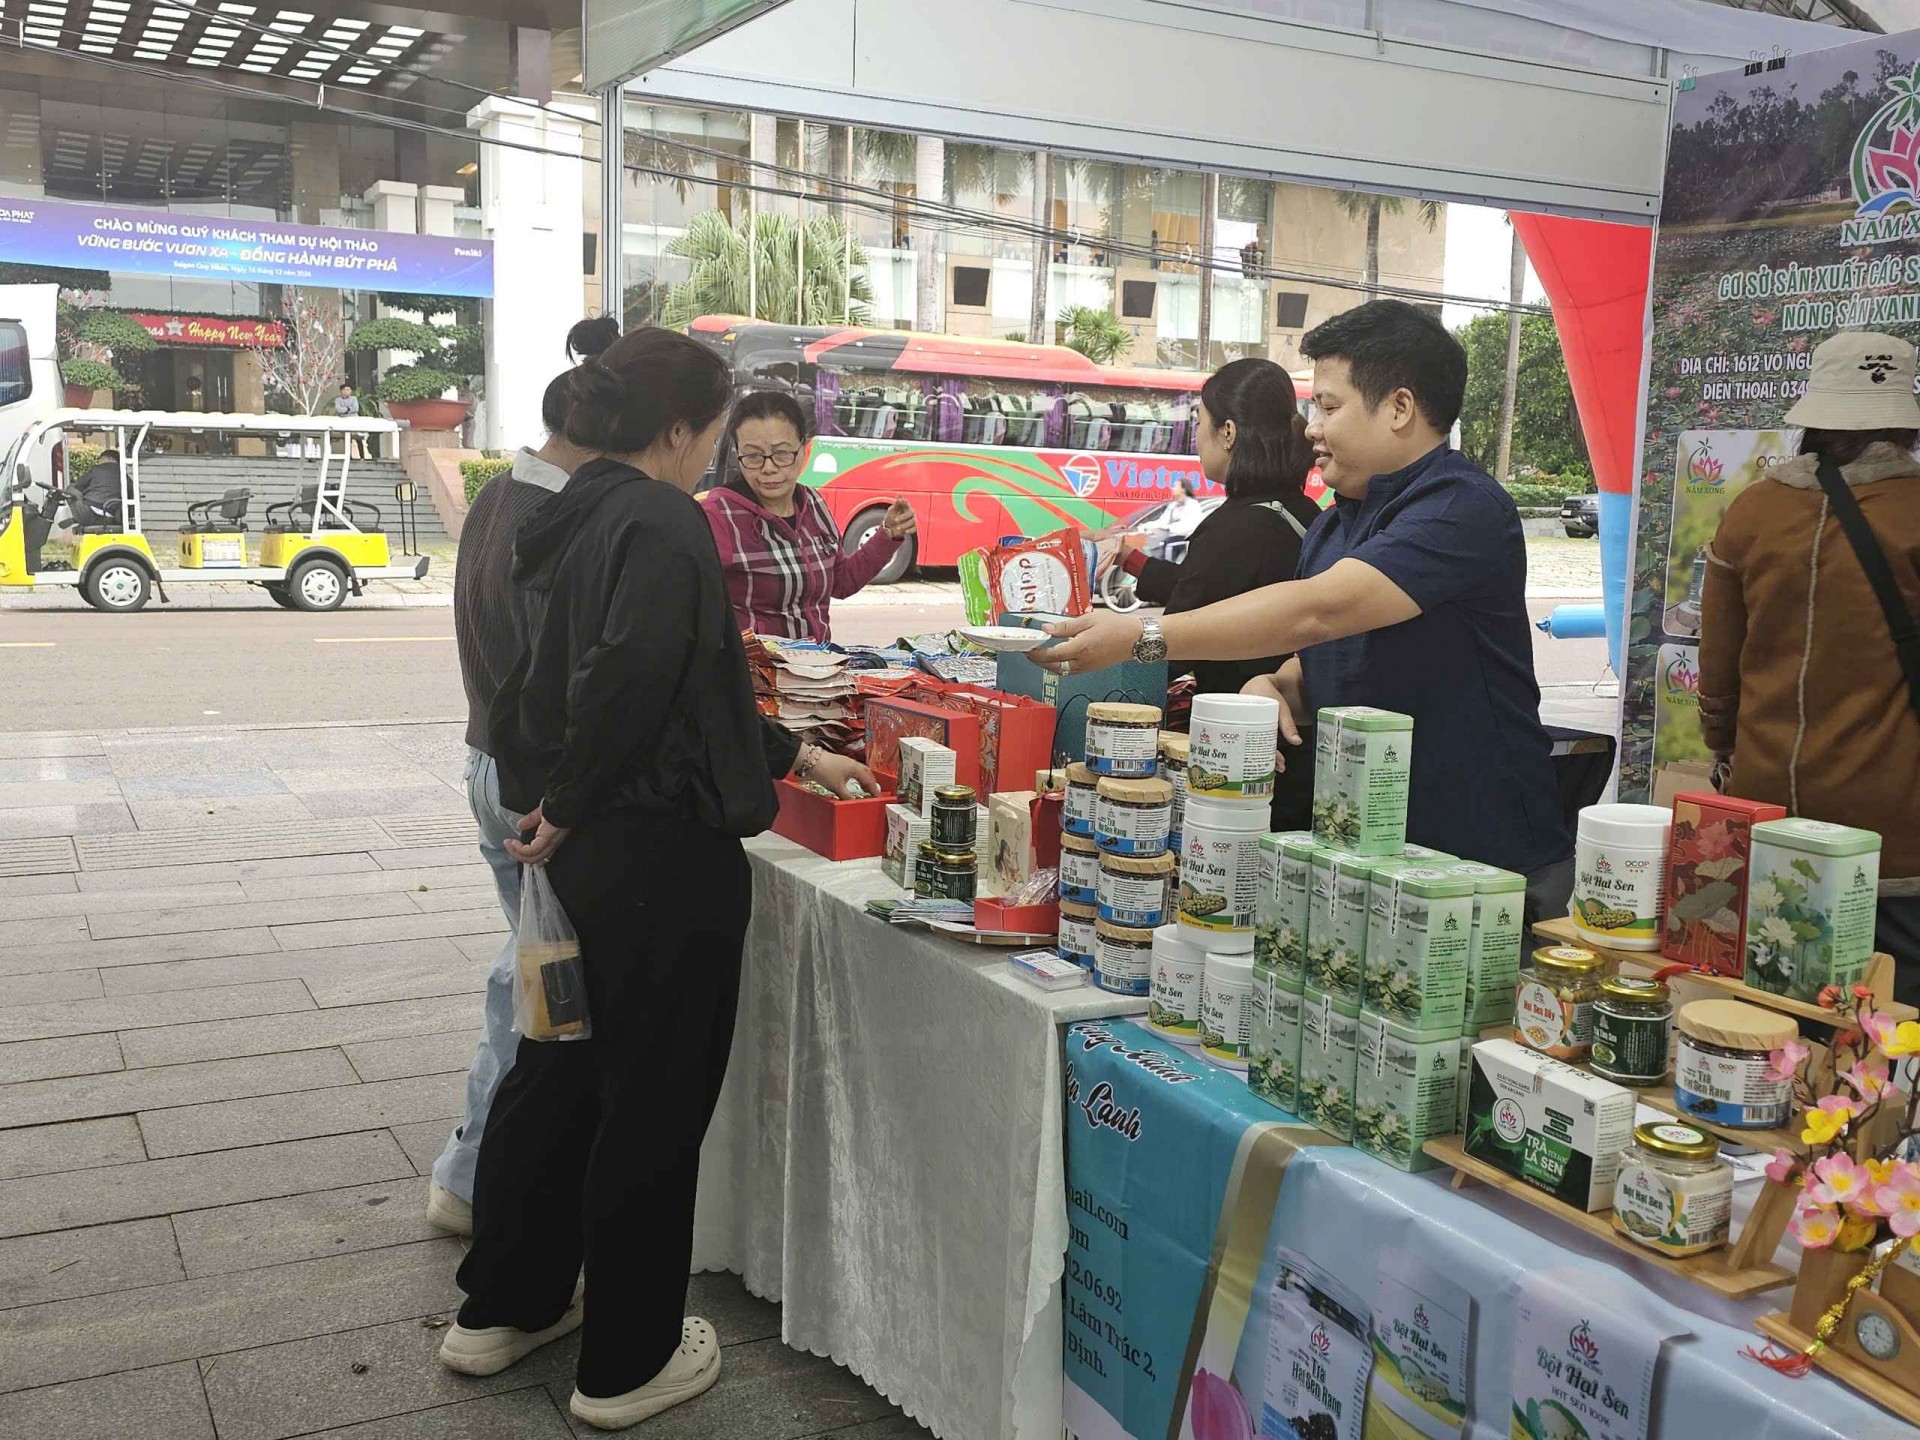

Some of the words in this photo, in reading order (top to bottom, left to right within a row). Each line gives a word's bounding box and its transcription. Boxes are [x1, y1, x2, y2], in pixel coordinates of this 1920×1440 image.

[93, 217, 133, 232] CHÀO
[136, 220, 177, 236] MỪNG
[181, 225, 209, 240] QUÝ
[212, 227, 256, 243] KHÁCH
[259, 232, 295, 246] THAM
[299, 236, 317, 249] DỰ
[320, 236, 341, 252] HỘI
[344, 238, 378, 252] THẢO
[78, 233, 121, 249] VỮNG
[122, 239, 164, 253] BƯỚC
[166, 242, 208, 257] VƯƠN
[209, 246, 229, 258] XA
[239, 246, 286, 264] ĐỒNG
[287, 249, 332, 267] HÀNH
[334, 254, 366, 270] BỨT
[366, 257, 398, 273] PHÁ
[1719, 272, 1743, 299] CƠ
[1746, 264, 1771, 297] SỞ
[1775, 262, 1811, 296] SẢN
[1815, 256, 1867, 293] XUẤT
[1869, 253, 1901, 287] CÁC
[1905, 253, 1920, 284] S
[1783, 301, 1833, 331] NÔNG
[1836, 294, 1871, 328] SẢN
[188, 321, 226, 342] Happy
[227, 325, 253, 340] New
[1680, 356, 1702, 375] ĐỊA
[1733, 354, 1760, 373] 1612
[1703, 379, 1732, 402] ĐIỆN
[1735, 381, 1777, 401] THOẠI:
[1780, 380, 1809, 399] 034
[1220, 732, 1240, 741] OCOP
[1197, 745, 1210, 759] Hạt
[1211, 748, 1227, 760] Sen
[1212, 841, 1233, 850] OCOP
[1189, 860, 1204, 875] Hạt
[1206, 863, 1227, 877] Sen
[1625, 860, 1650, 869] OCOP
[1593, 875, 1612, 891] Hạt
[1614, 879, 1635, 892] Sen
[1175, 972, 1195, 981] OCOP
[1168, 987, 1184, 998] Sen
[1697, 1070, 1712, 1084] Trà
[1693, 1081, 1708, 1095] Sen
[1708, 1085, 1732, 1101] Rang
[1081, 1081, 1141, 1142] Lành
[1525, 1133, 1548, 1154] TRÀ
[1524, 1147, 1538, 1165] LÁ
[1540, 1156, 1563, 1177] SEN
[1648, 1195, 1664, 1211] Sen
[1069, 1295, 1103, 1337] Lâm
[1105, 1321, 1140, 1368] Trúc
[1142, 1350, 1157, 1383] 2,
[1393, 1318, 1409, 1340] Bột
[1410, 1329, 1429, 1352] Hạt
[1430, 1341, 1448, 1364] Sen
[1067, 1330, 1107, 1379] Định.
[1536, 1344, 1563, 1379] Bột
[1564, 1363, 1599, 1400] Hạt
[1602, 1383, 1630, 1421] Sen
[1305, 1372, 1321, 1402] Sen
[1321, 1385, 1343, 1420] Rang
[1570, 1396, 1587, 1413] SEN
[1589, 1407, 1611, 1428] 100%
